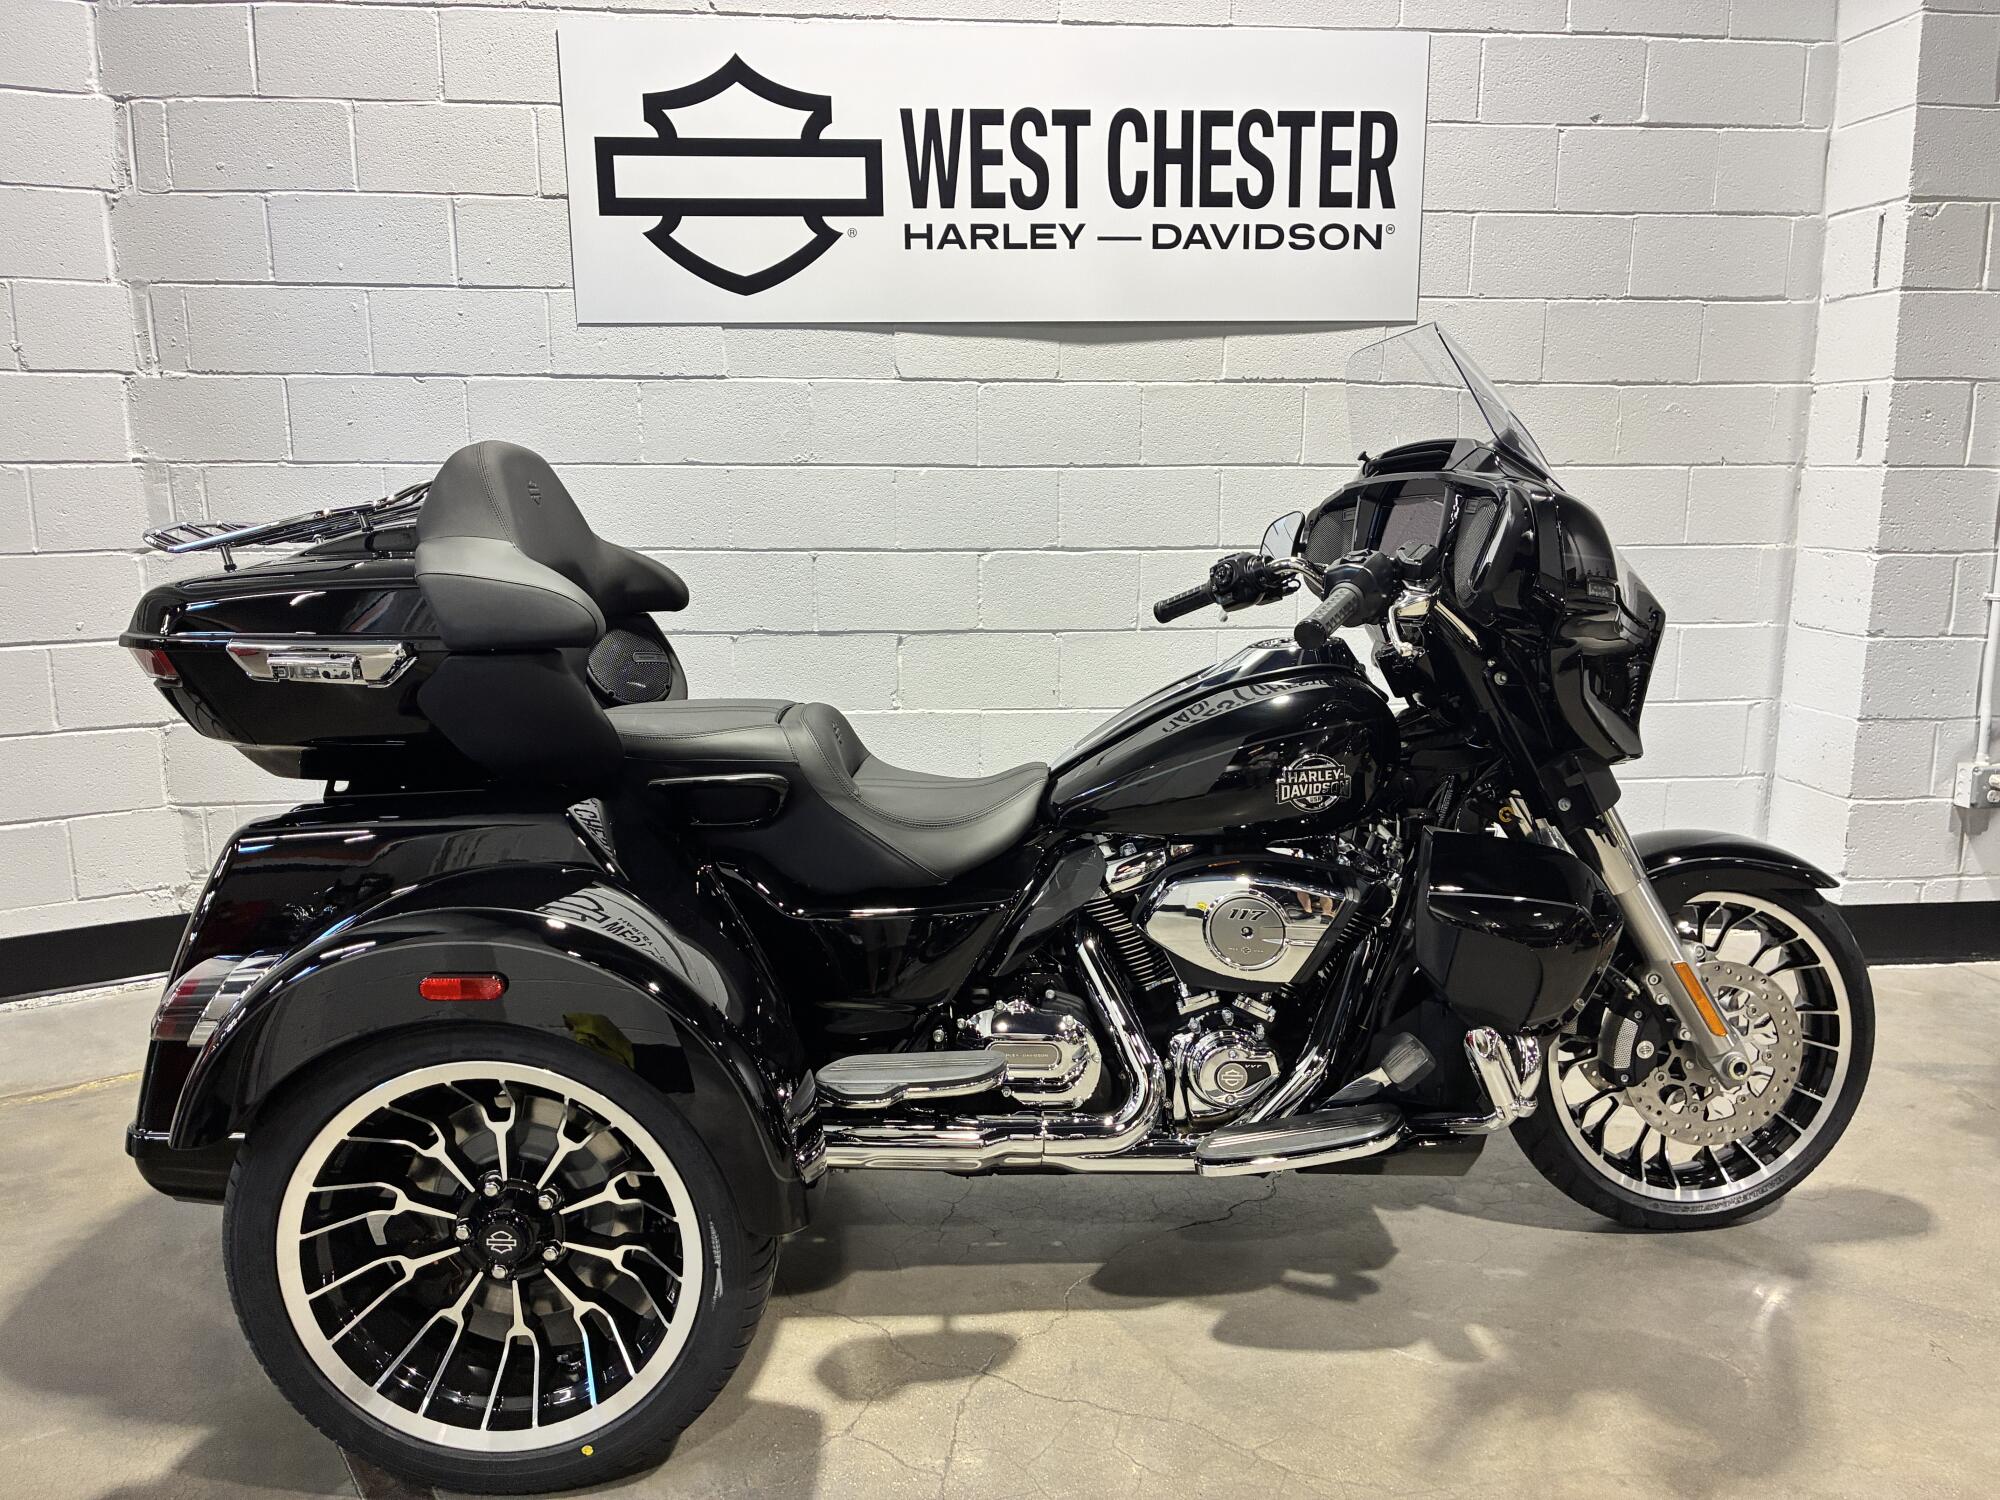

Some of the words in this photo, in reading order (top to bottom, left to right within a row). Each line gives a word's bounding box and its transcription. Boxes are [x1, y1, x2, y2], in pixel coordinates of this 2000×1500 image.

[900, 107, 1091, 210] WEST
[1107, 107, 1398, 210] CHESTER
[904, 223, 1086, 250] HARLEY
[1281, 780, 1350, 801] DAVIDSON
[1228, 908, 1267, 921] 117
